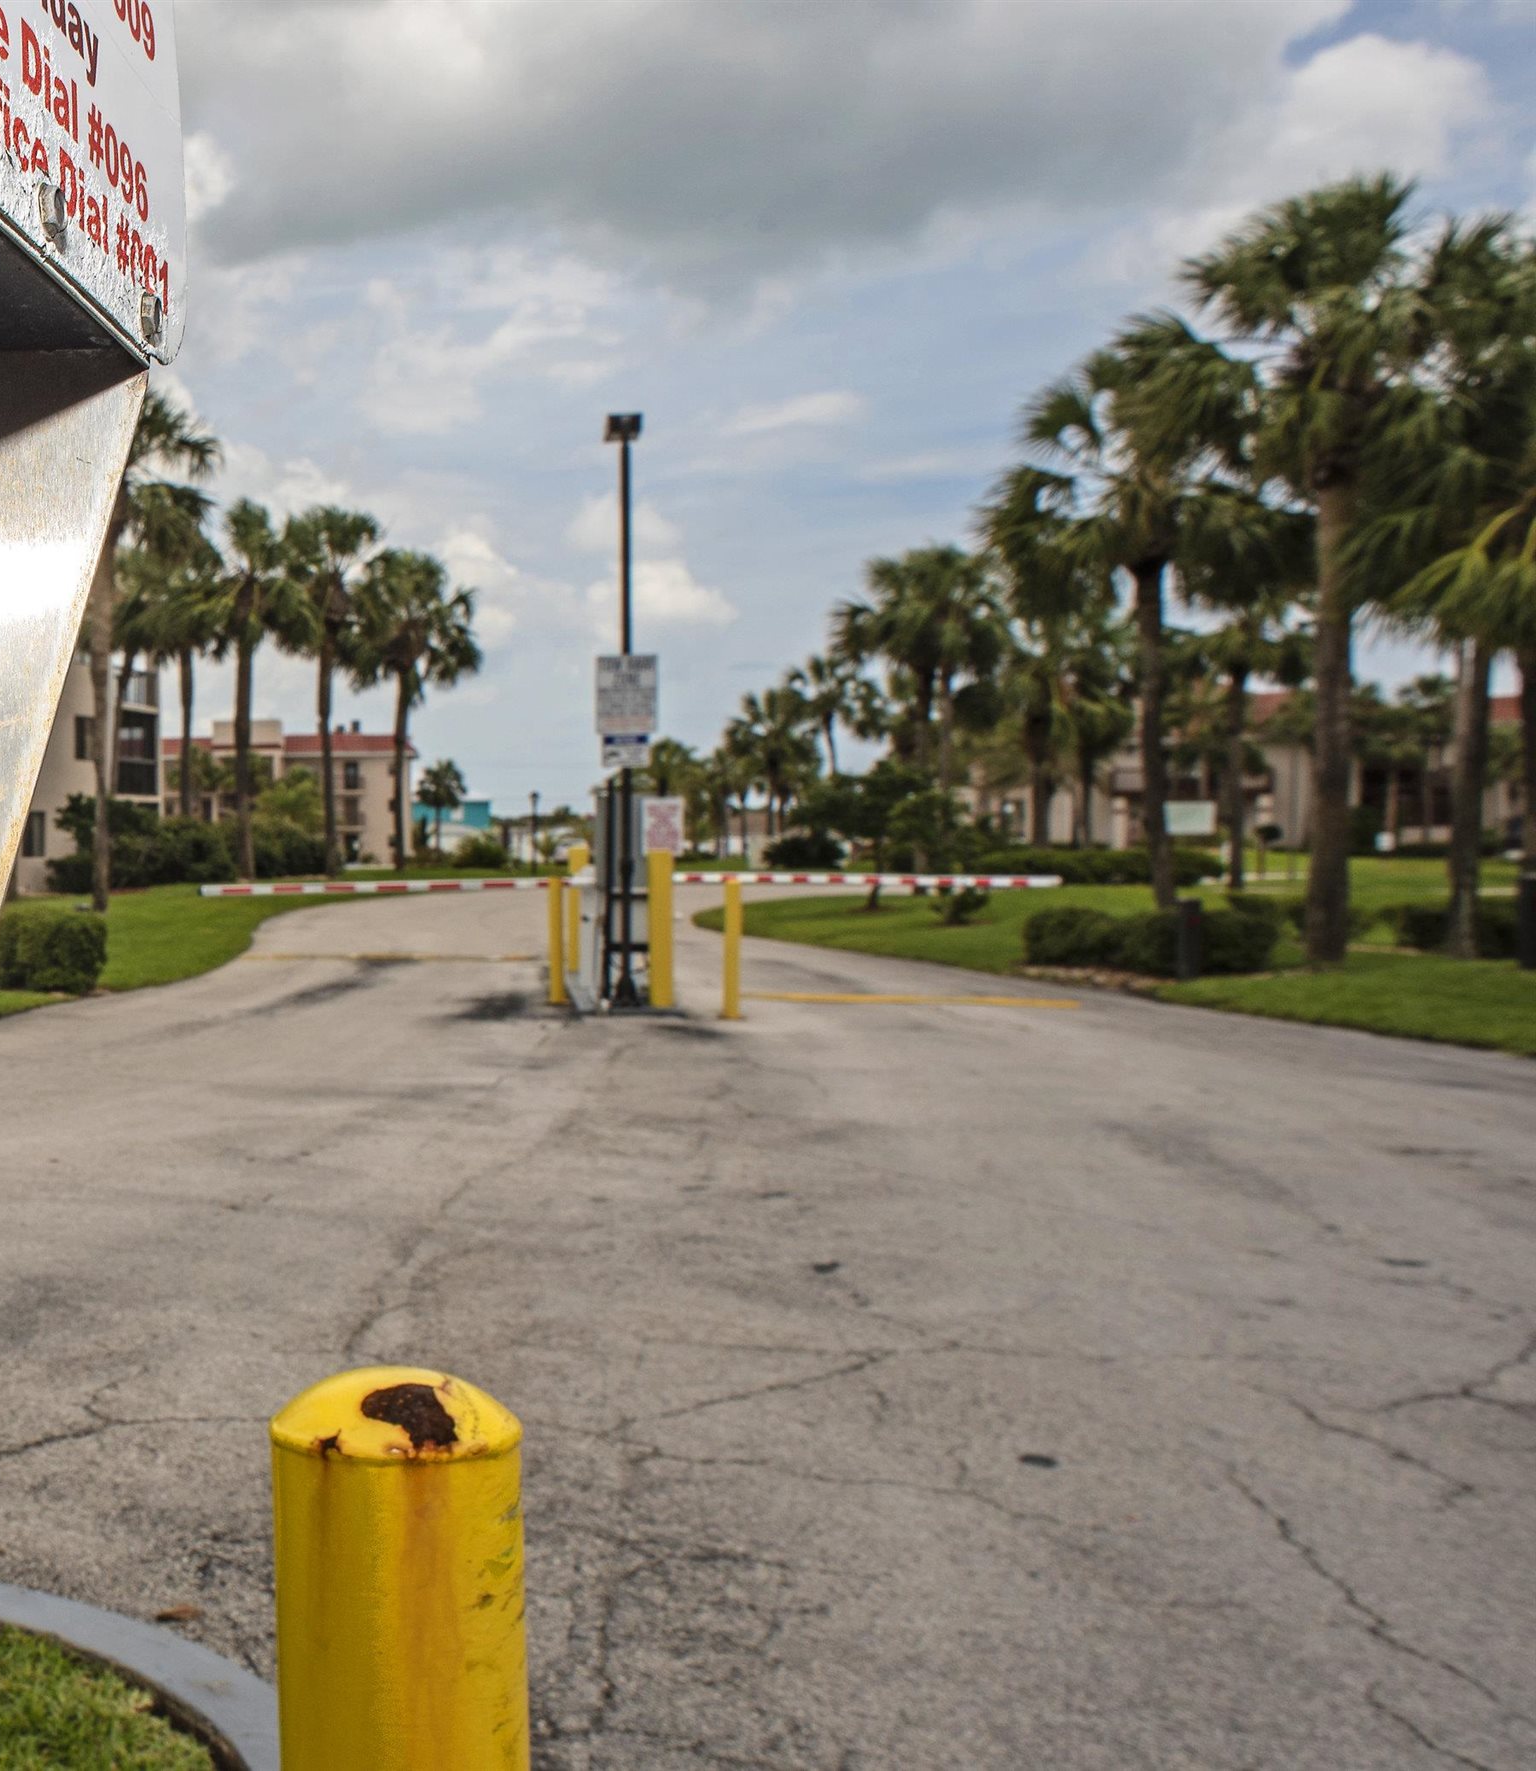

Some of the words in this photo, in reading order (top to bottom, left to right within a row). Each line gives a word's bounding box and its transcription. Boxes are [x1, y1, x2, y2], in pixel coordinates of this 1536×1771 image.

[21, 18, 79, 143] Dial
[88, 103, 148, 222] #096
[60, 147, 109, 255] Dial
